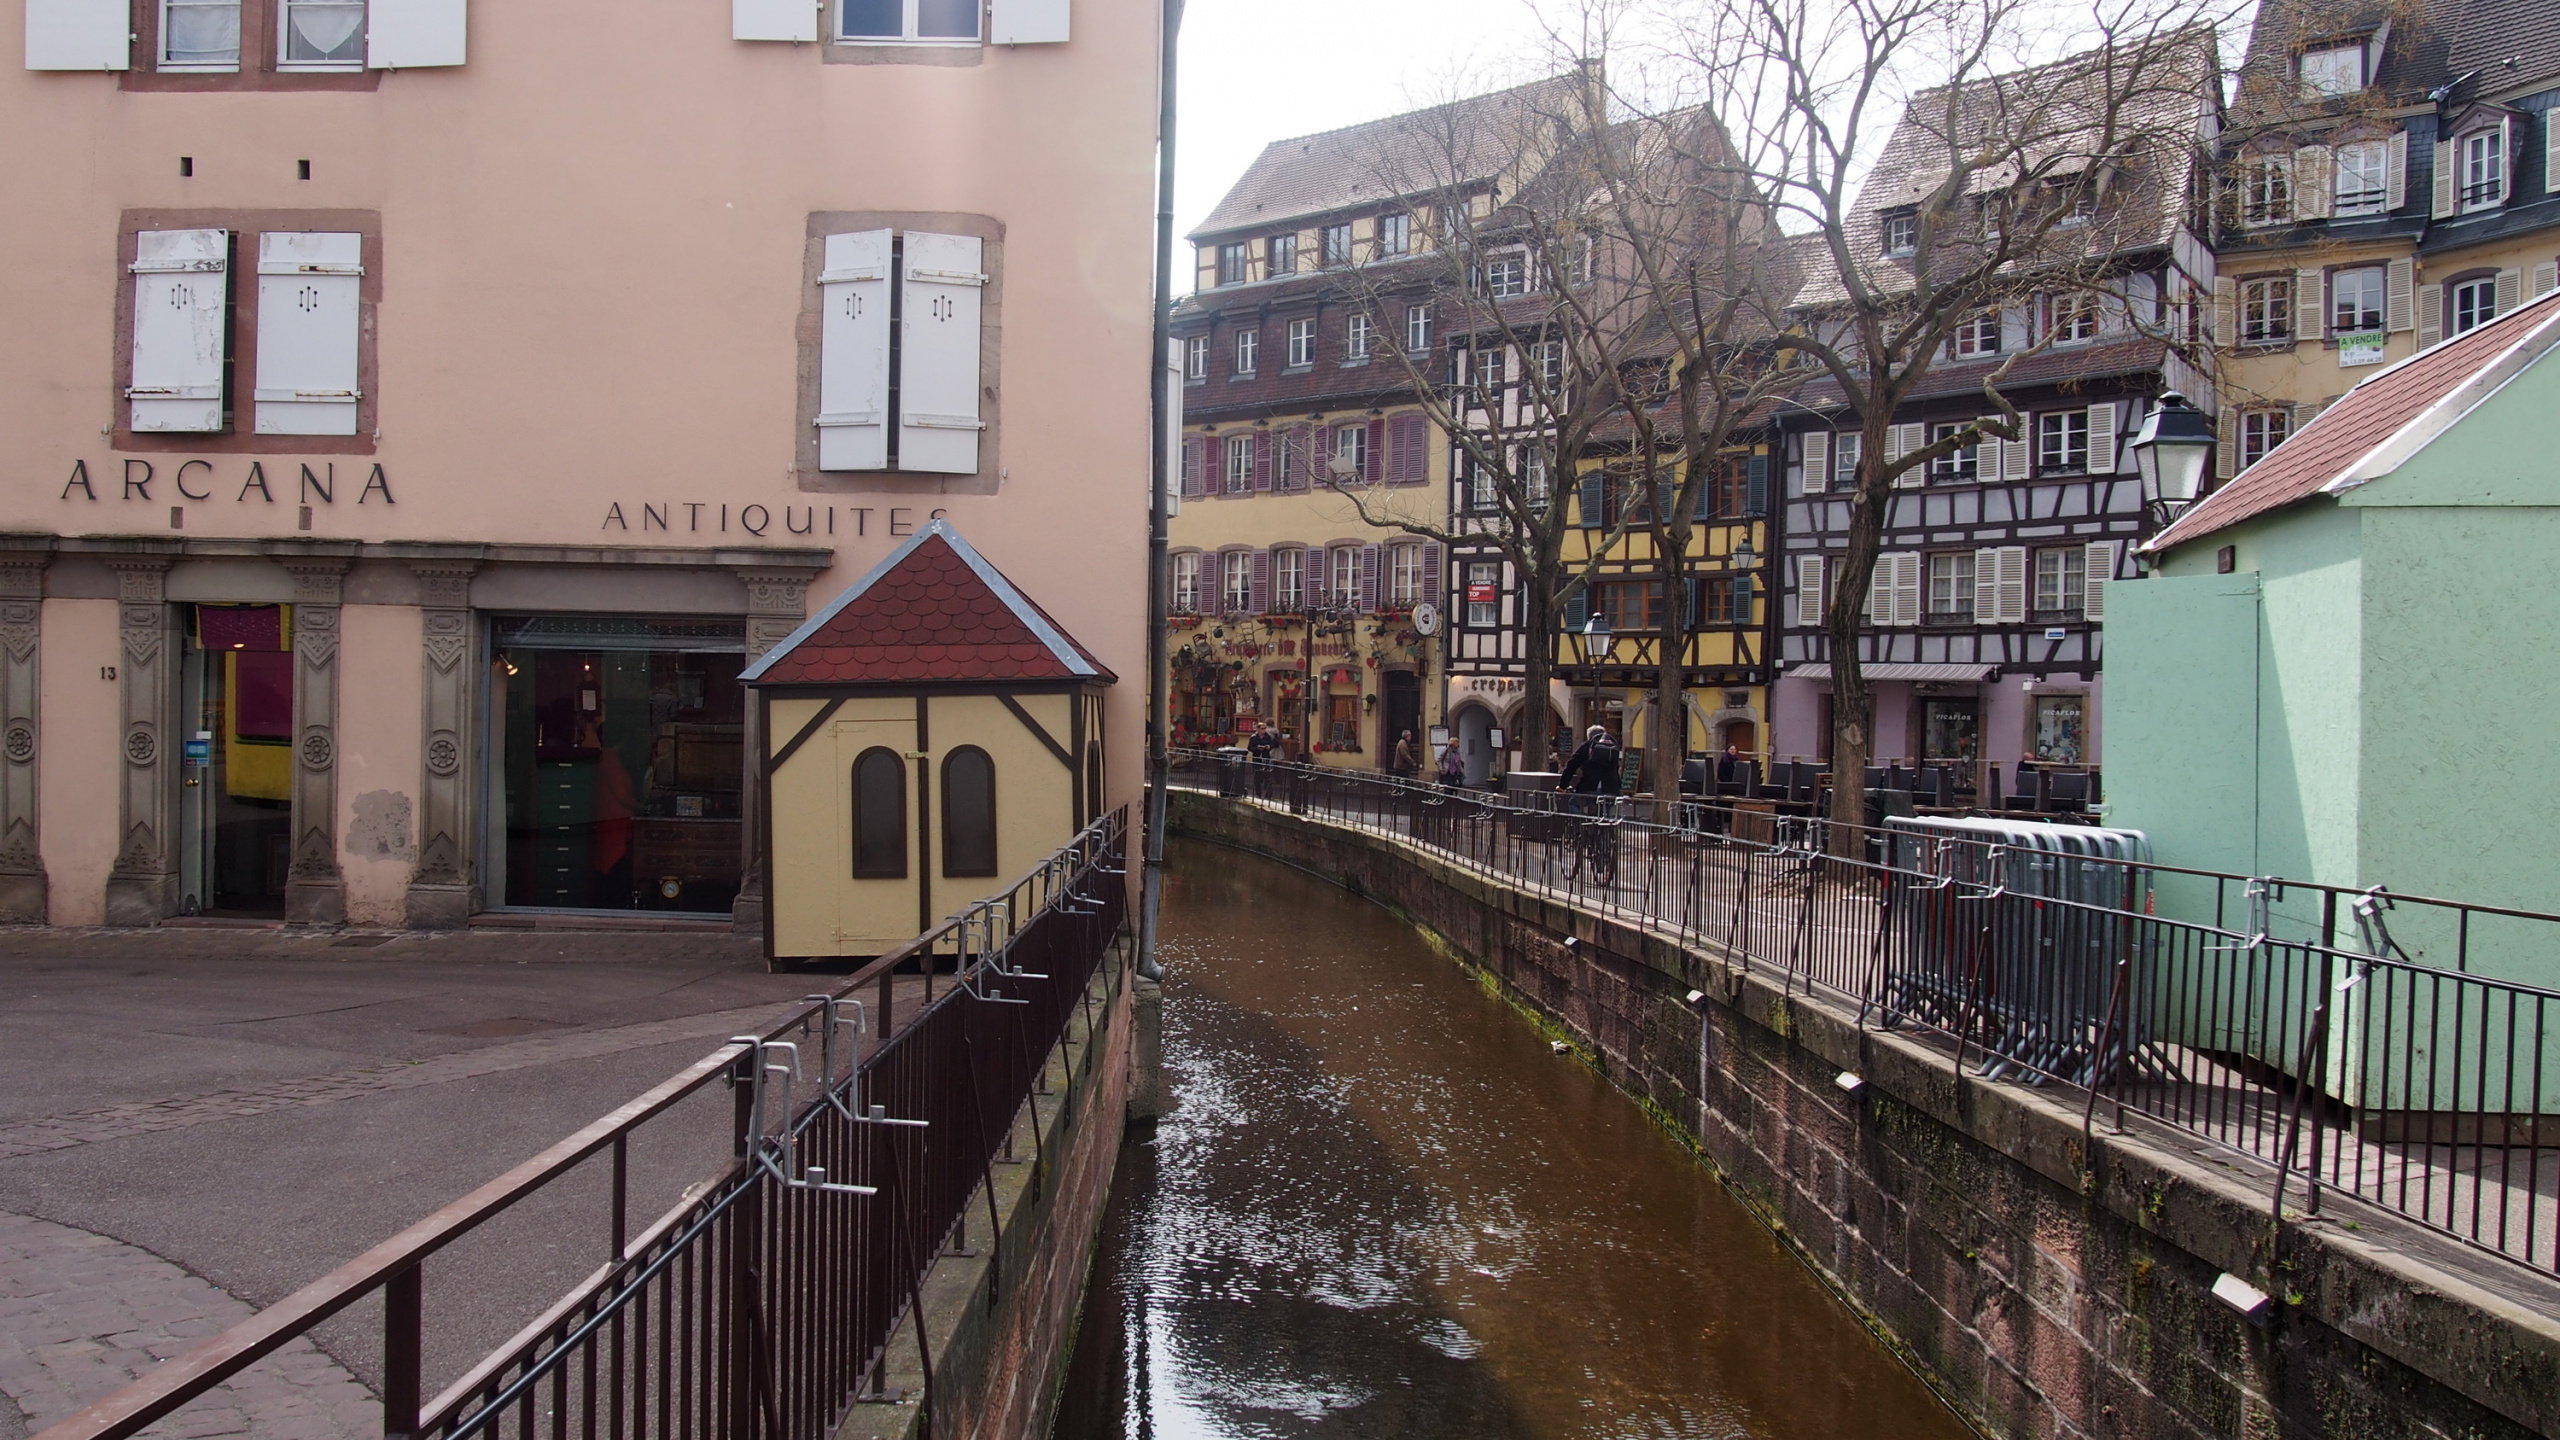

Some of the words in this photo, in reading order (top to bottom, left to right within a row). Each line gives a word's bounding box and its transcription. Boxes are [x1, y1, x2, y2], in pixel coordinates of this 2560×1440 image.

[2341, 337, 2348, 346] A
[2349, 333, 2382, 345] VENDRE
[60, 458, 396, 504] ARCANA
[100, 665, 117, 681] 13
[2042, 709, 2081, 717] PICAFLOR
